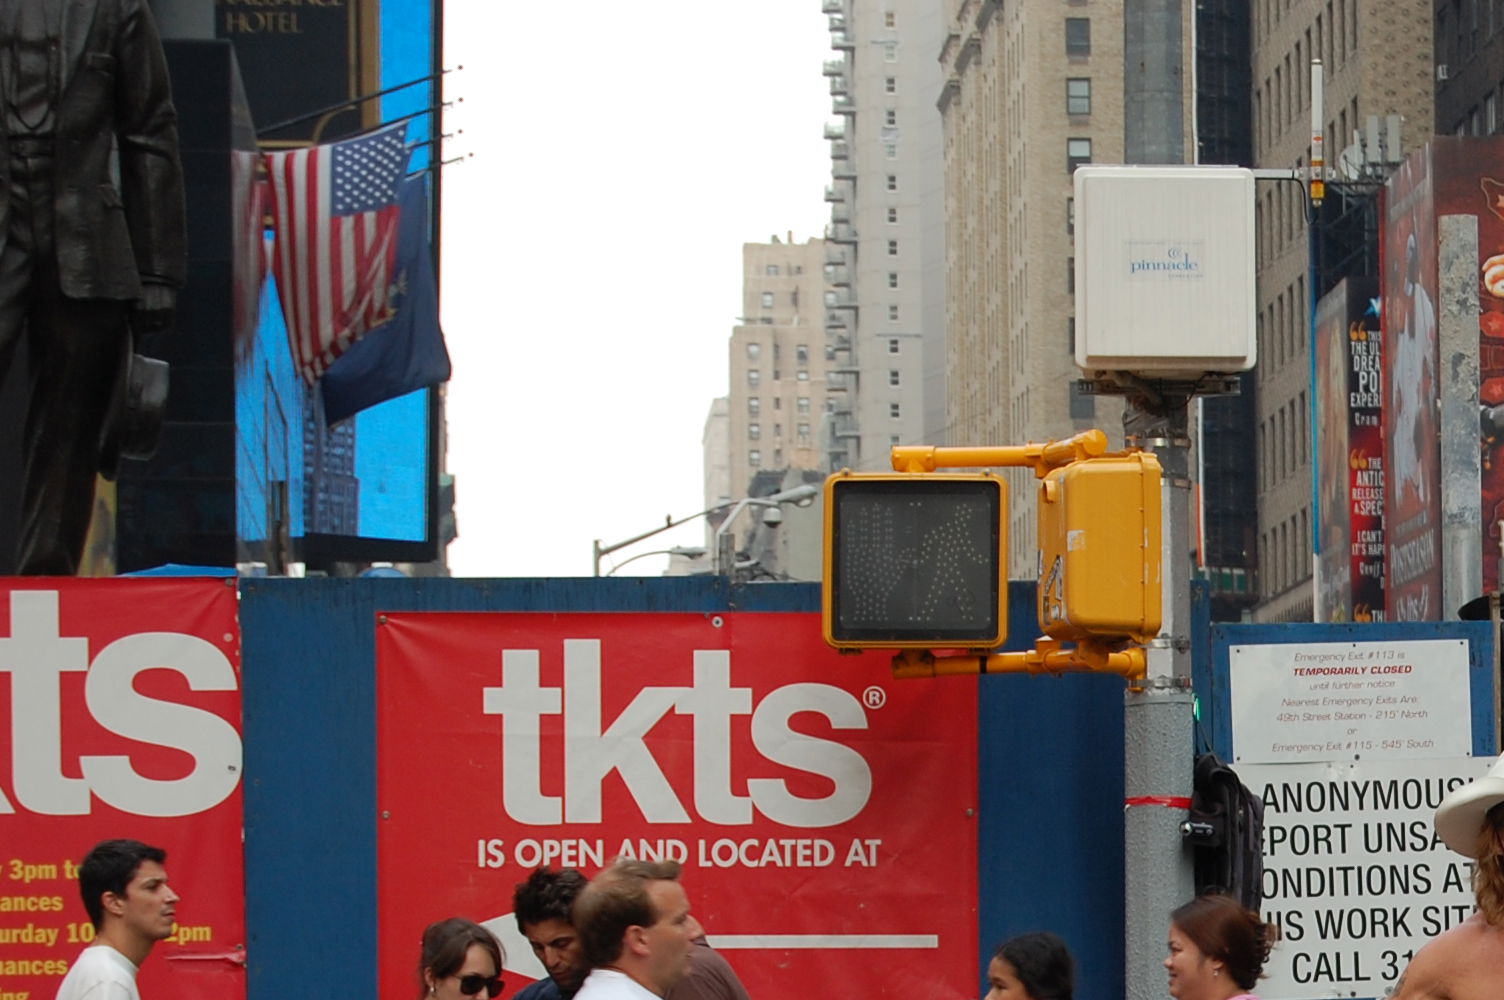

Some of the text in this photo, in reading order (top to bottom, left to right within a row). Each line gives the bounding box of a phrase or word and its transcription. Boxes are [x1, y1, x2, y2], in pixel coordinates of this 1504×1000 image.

[225, 11, 304, 34] HOTEL
[1131, 252, 1198, 274] pinnacle
[1368, 457, 1382, 469] THE
[1293, 664, 1412, 677] TEMPORARILY CLOSED
[1367, 680, 1396, 689] notice
[1322, 697, 1374, 708] Emergency
[1401, 709, 1428, 719] North
[1272, 743, 1324, 754] Emergency
[1406, 739, 1434, 750] South
[1262, 776, 1474, 814] ANONYMOU
[477, 838, 882, 869] IS OPEN AND LOCATED AT
[9, 859, 57, 883] 3pm
[1314, 906, 1412, 940] WORK
[1292, 951, 1372, 984] CALL
